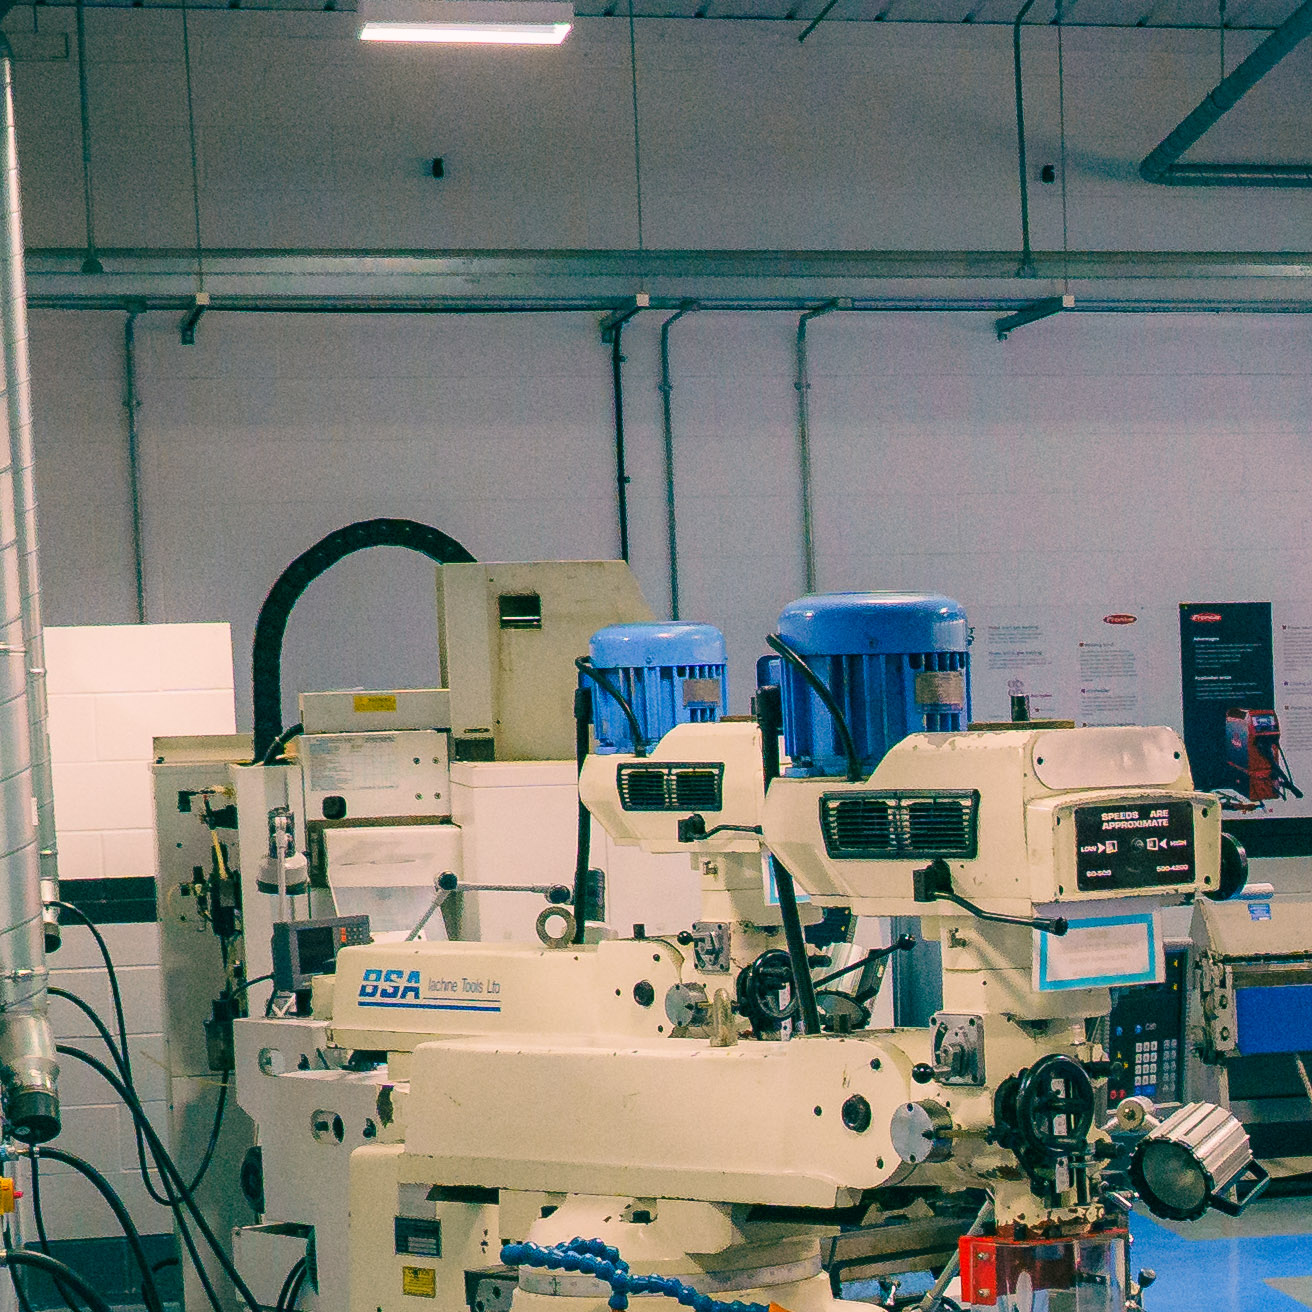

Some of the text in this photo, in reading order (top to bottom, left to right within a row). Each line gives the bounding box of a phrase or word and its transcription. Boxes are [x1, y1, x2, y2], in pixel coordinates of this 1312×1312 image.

[1101, 809, 1169, 821] SPEEDS ARE
[1102, 818, 1169, 830] APPROXIMATE
[358, 968, 421, 999] BSA
[462, 977, 484, 993] Tools
